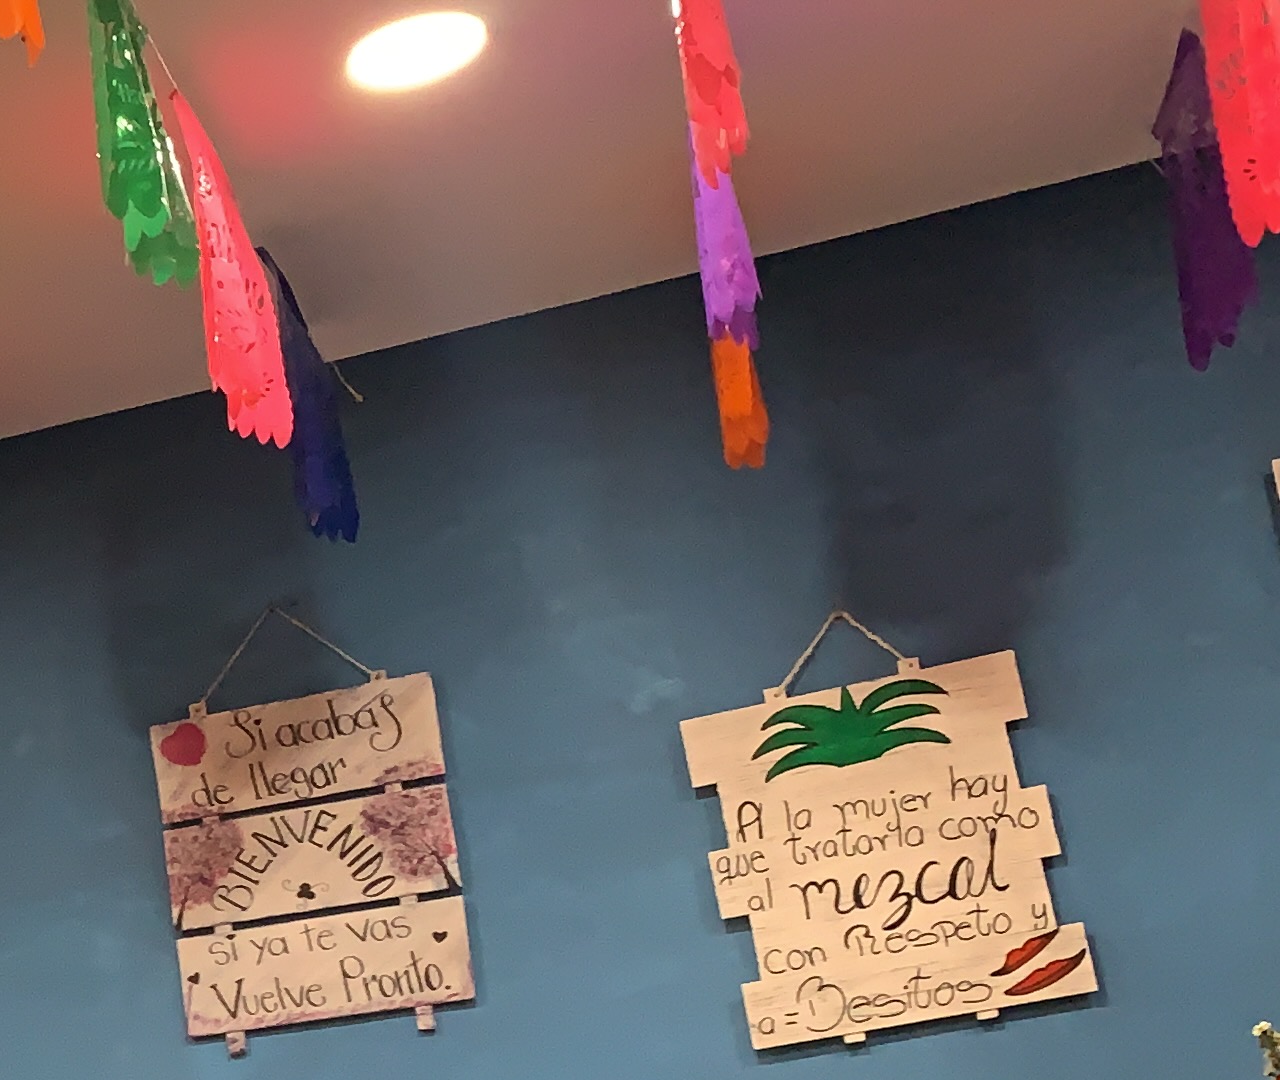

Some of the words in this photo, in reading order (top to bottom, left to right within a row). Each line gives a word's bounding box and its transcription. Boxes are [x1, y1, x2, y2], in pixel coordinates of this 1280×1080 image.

[225, 709, 267, 758] Si
[191, 773, 234, 808] de
[249, 757, 346, 800] llegar
[736, 801, 765, 844] A
[784, 800, 813, 832] la
[833, 790, 932, 833] mujer
[949, 765, 1008, 815] hay
[213, 809, 396, 913] BIENVENIDO
[716, 851, 770, 887] que
[784, 823, 925, 866] tratarla
[938, 805, 1041, 842] como
[747, 878, 774, 913] al
[789, 828, 1010, 932] mezcal
[209, 933, 238, 965] si
[250, 935, 289, 966] ya
[300, 924, 337, 952] te
[345, 915, 412, 943] vas
[762, 943, 828, 975] con
[843, 903, 1013, 958] Respeto
[1031, 903, 1049, 931] y
[210, 976, 327, 1020] Vuelve
